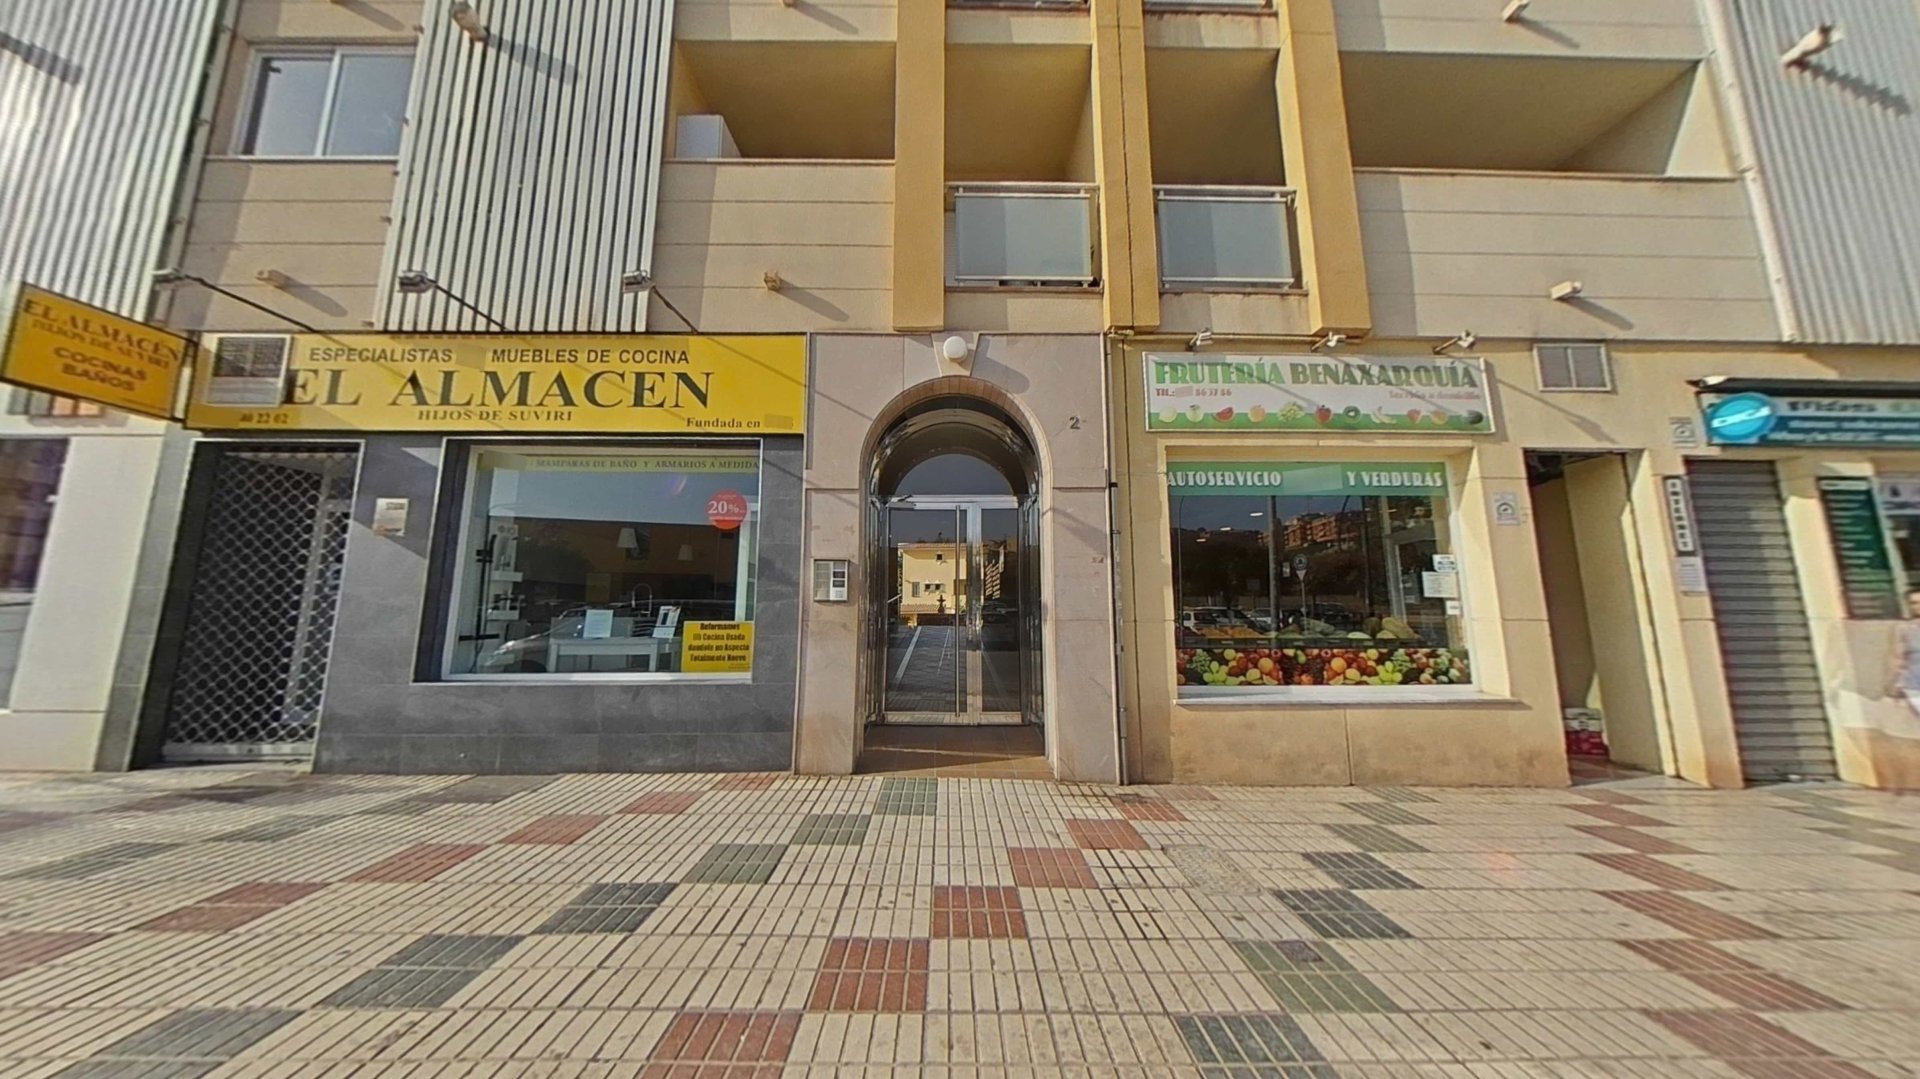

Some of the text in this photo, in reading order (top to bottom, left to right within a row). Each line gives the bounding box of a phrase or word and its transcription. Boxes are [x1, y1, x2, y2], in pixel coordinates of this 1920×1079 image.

[24, 299, 57, 323] EL
[53, 347, 148, 381] COCINAS
[309, 347, 690, 365] ESPECIALISTAS MUEBLES DE COCINA
[61, 362, 136, 392] BAÑOS
[1155, 356, 1479, 388] FRUTERÍA BENAXARQUÍA
[284, 368, 715, 409] EL ALMACEN
[417, 409, 573, 422] HIJOS DE SUVIRI
[686, 417, 743, 429] Fundada
[746, 419, 761, 429] en
[1069, 415, 1081, 430] 2
[610, 457, 637, 469] BAÑO
[644, 460, 650, 469] Y
[654, 460, 707, 470] ARMARIOS
[710, 460, 717, 470] A
[719, 460, 759, 470] MEDIDA
[1168, 471, 1282, 487] AUTOSERVICIO
[1346, 471, 1356, 487] Y
[1361, 471, 1443, 487] VERDURAS
[707, 500, 740, 514] 20%
[702, 632, 725, 641] Cocina
